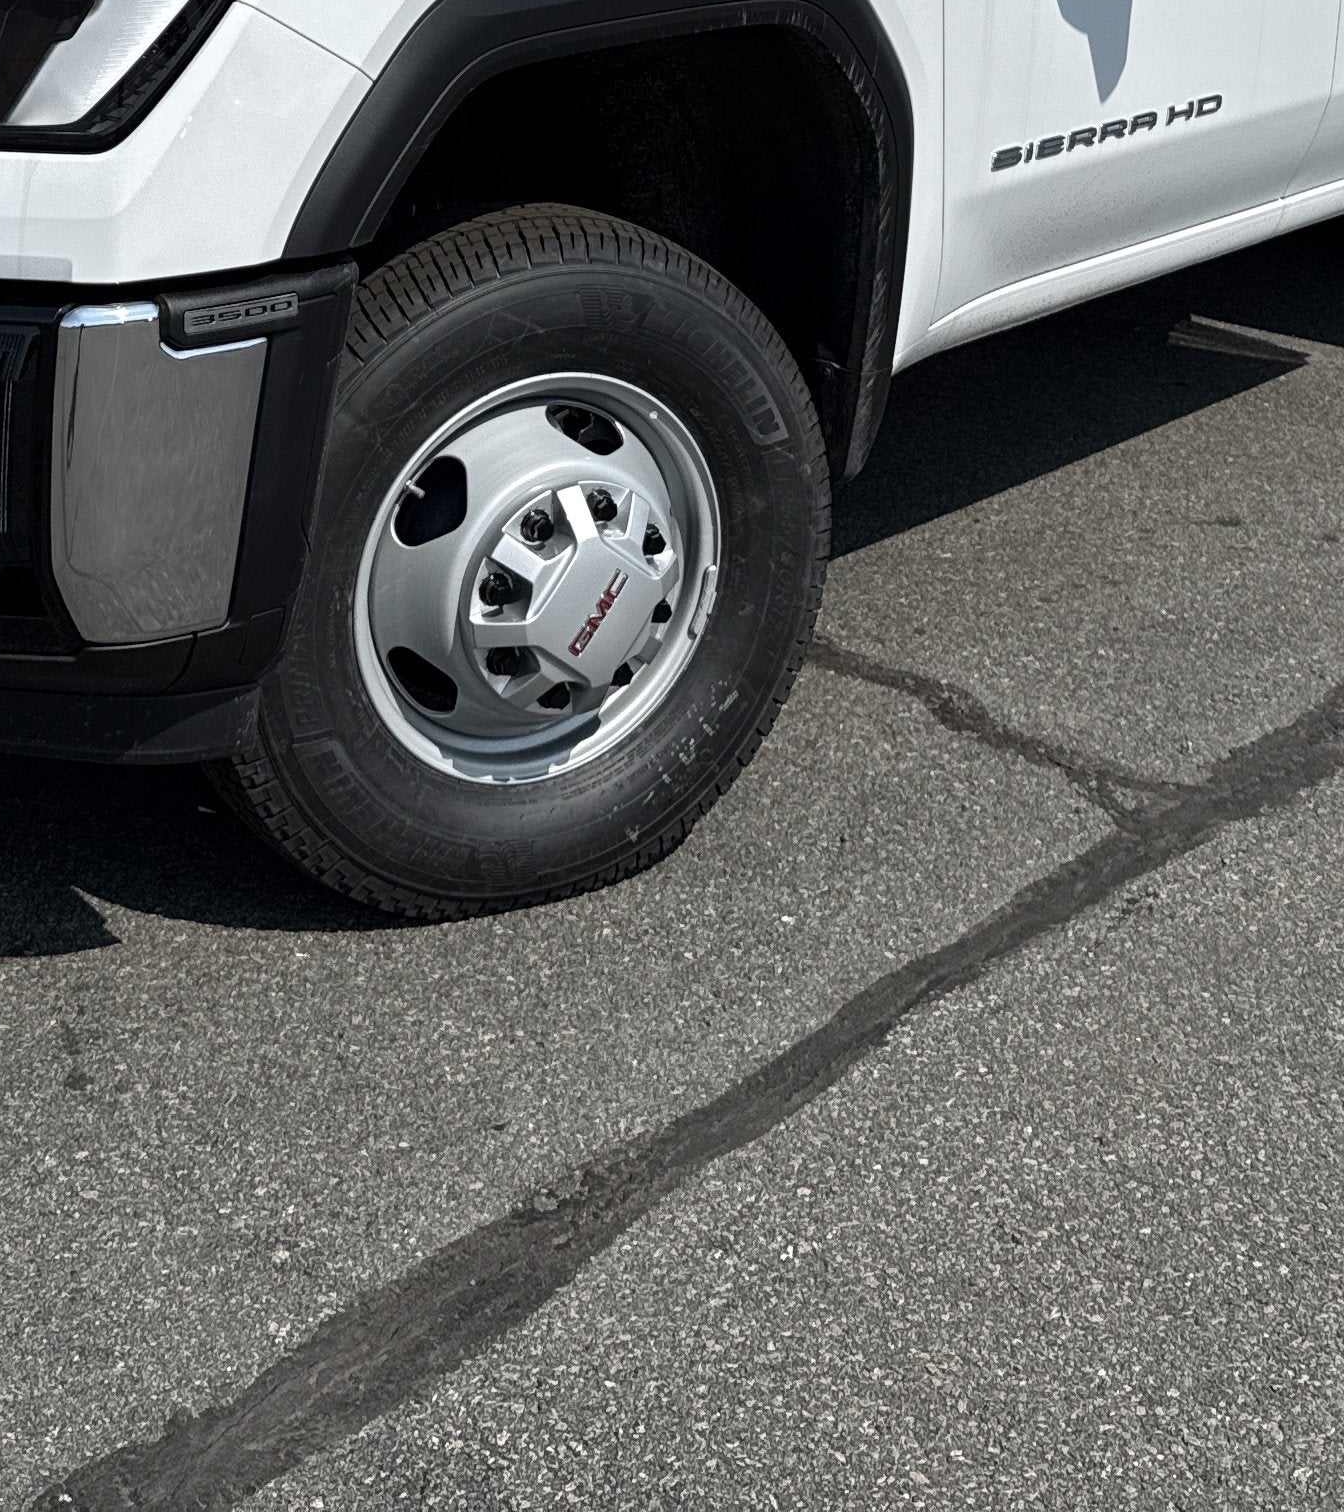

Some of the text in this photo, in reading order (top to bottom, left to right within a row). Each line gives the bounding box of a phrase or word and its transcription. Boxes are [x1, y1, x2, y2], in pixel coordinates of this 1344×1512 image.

[991, 94, 1223, 172] SIERRA HD
[191, 301, 293, 327] 3500
[568, 568, 629, 656] GMC
